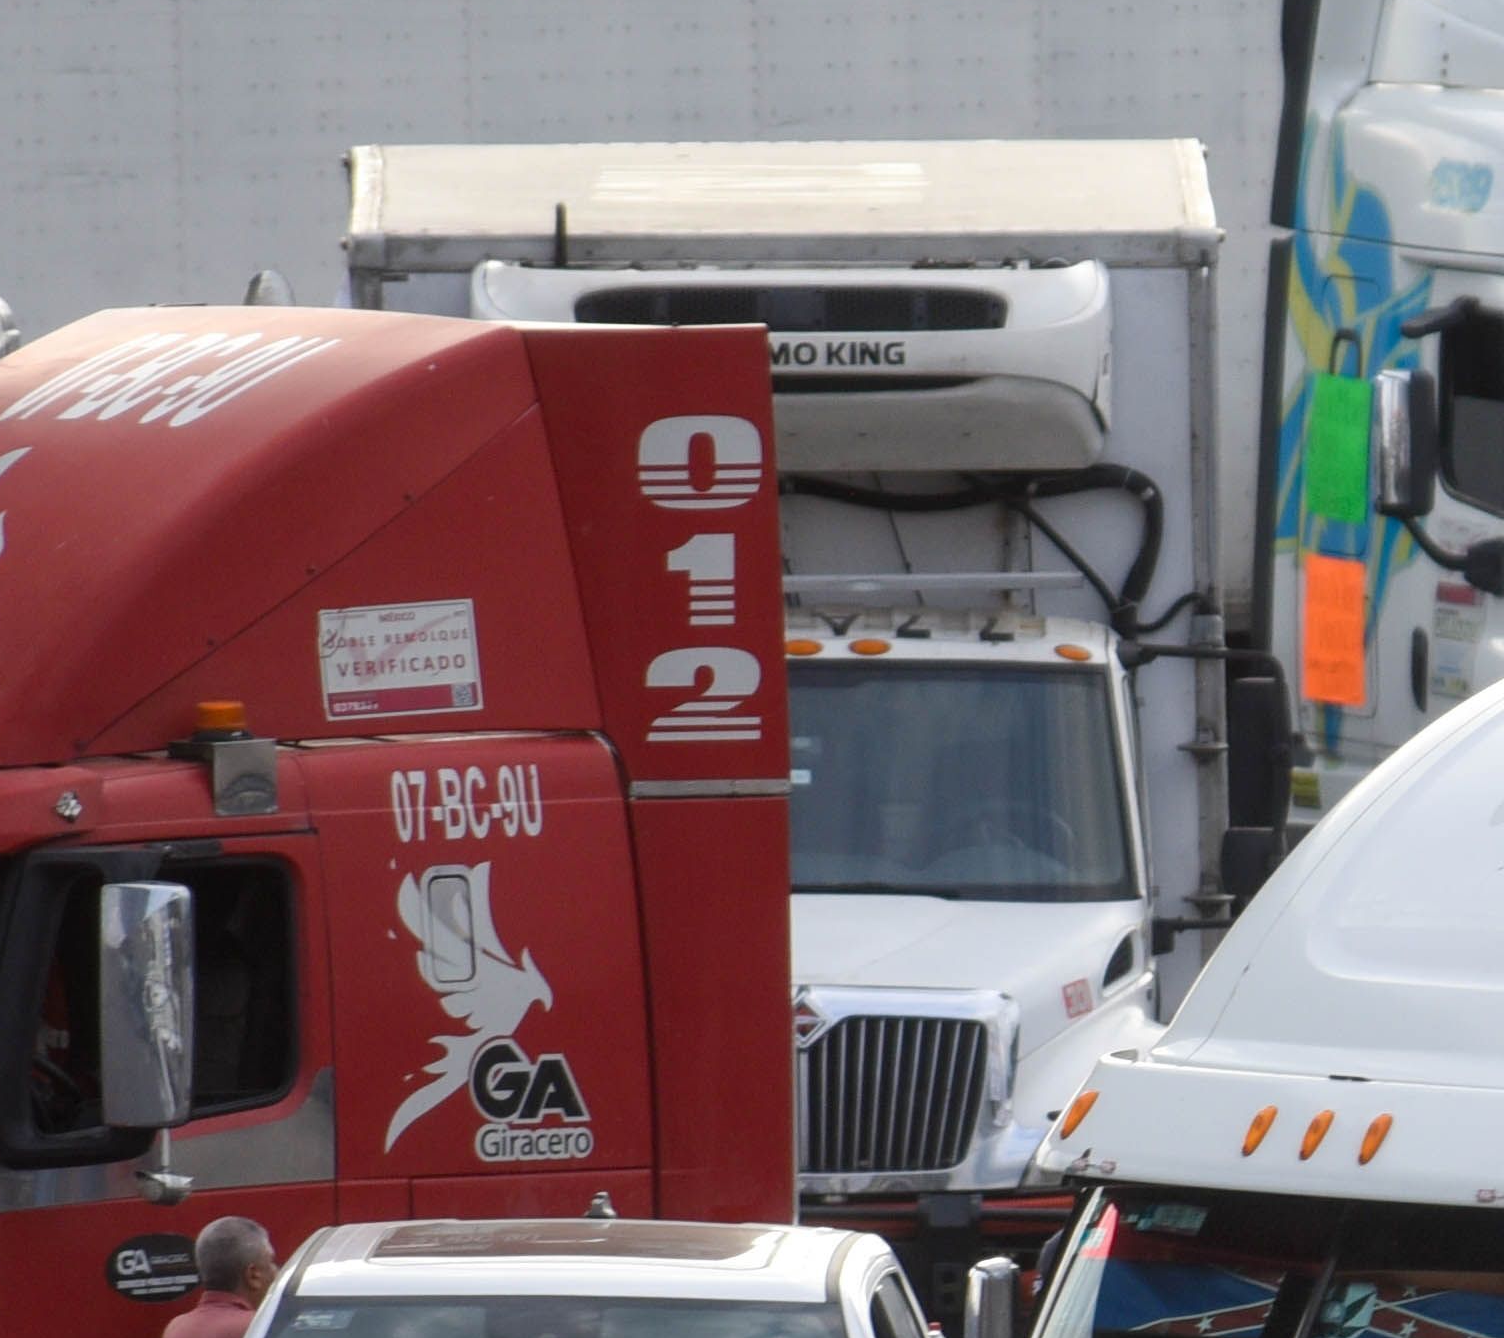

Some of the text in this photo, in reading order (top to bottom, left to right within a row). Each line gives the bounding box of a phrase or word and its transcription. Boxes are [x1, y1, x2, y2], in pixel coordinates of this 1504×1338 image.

[826, 341, 907, 366] KING
[383, 628, 471, 646] REMOLQUE
[335, 653, 467, 679] VERIFICADO
[390, 762, 544, 844] 07-BC-9U
[471, 1039, 592, 1123] GA
[479, 1128, 593, 1160] Giracero
[116, 1248, 152, 1275] GA
